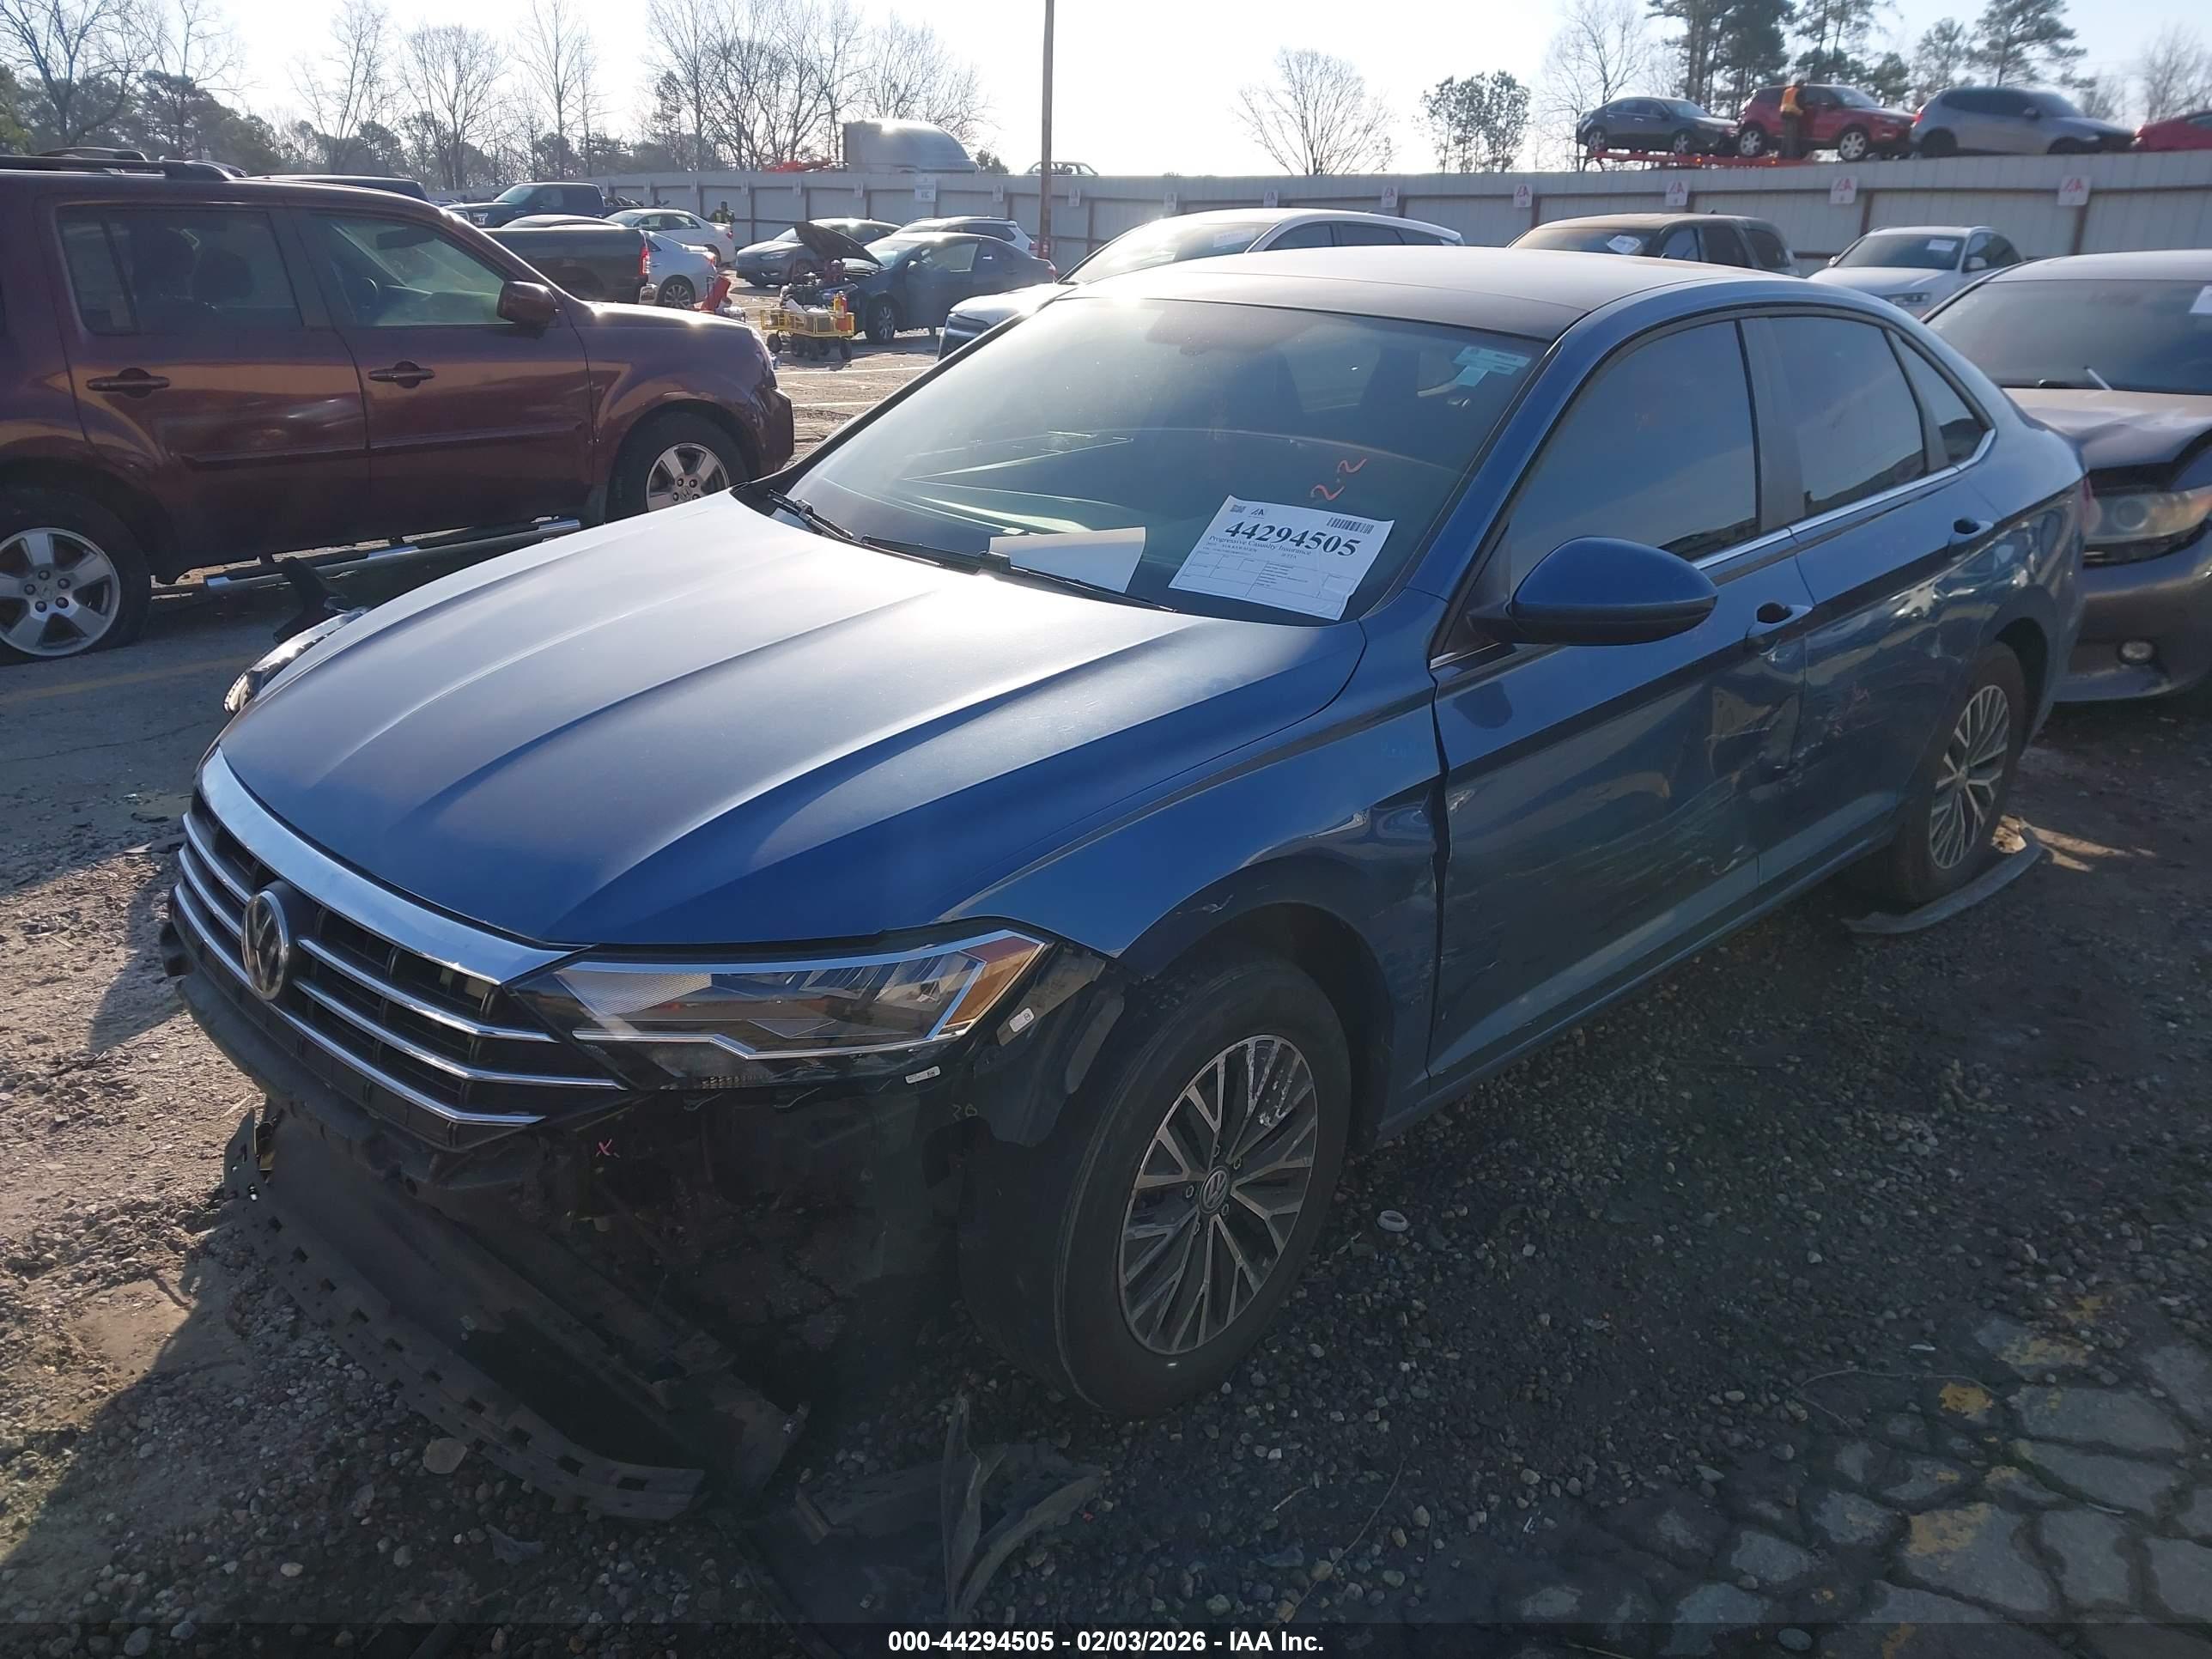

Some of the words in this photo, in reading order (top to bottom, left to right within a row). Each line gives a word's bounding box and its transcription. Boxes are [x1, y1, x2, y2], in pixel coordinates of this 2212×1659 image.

[1209, 535, 1248, 546] Progressive
[1248, 541, 1276, 550] Casualty
[1279, 544, 1312, 556] Insurance
[1224, 520, 1361, 556] 44294505
